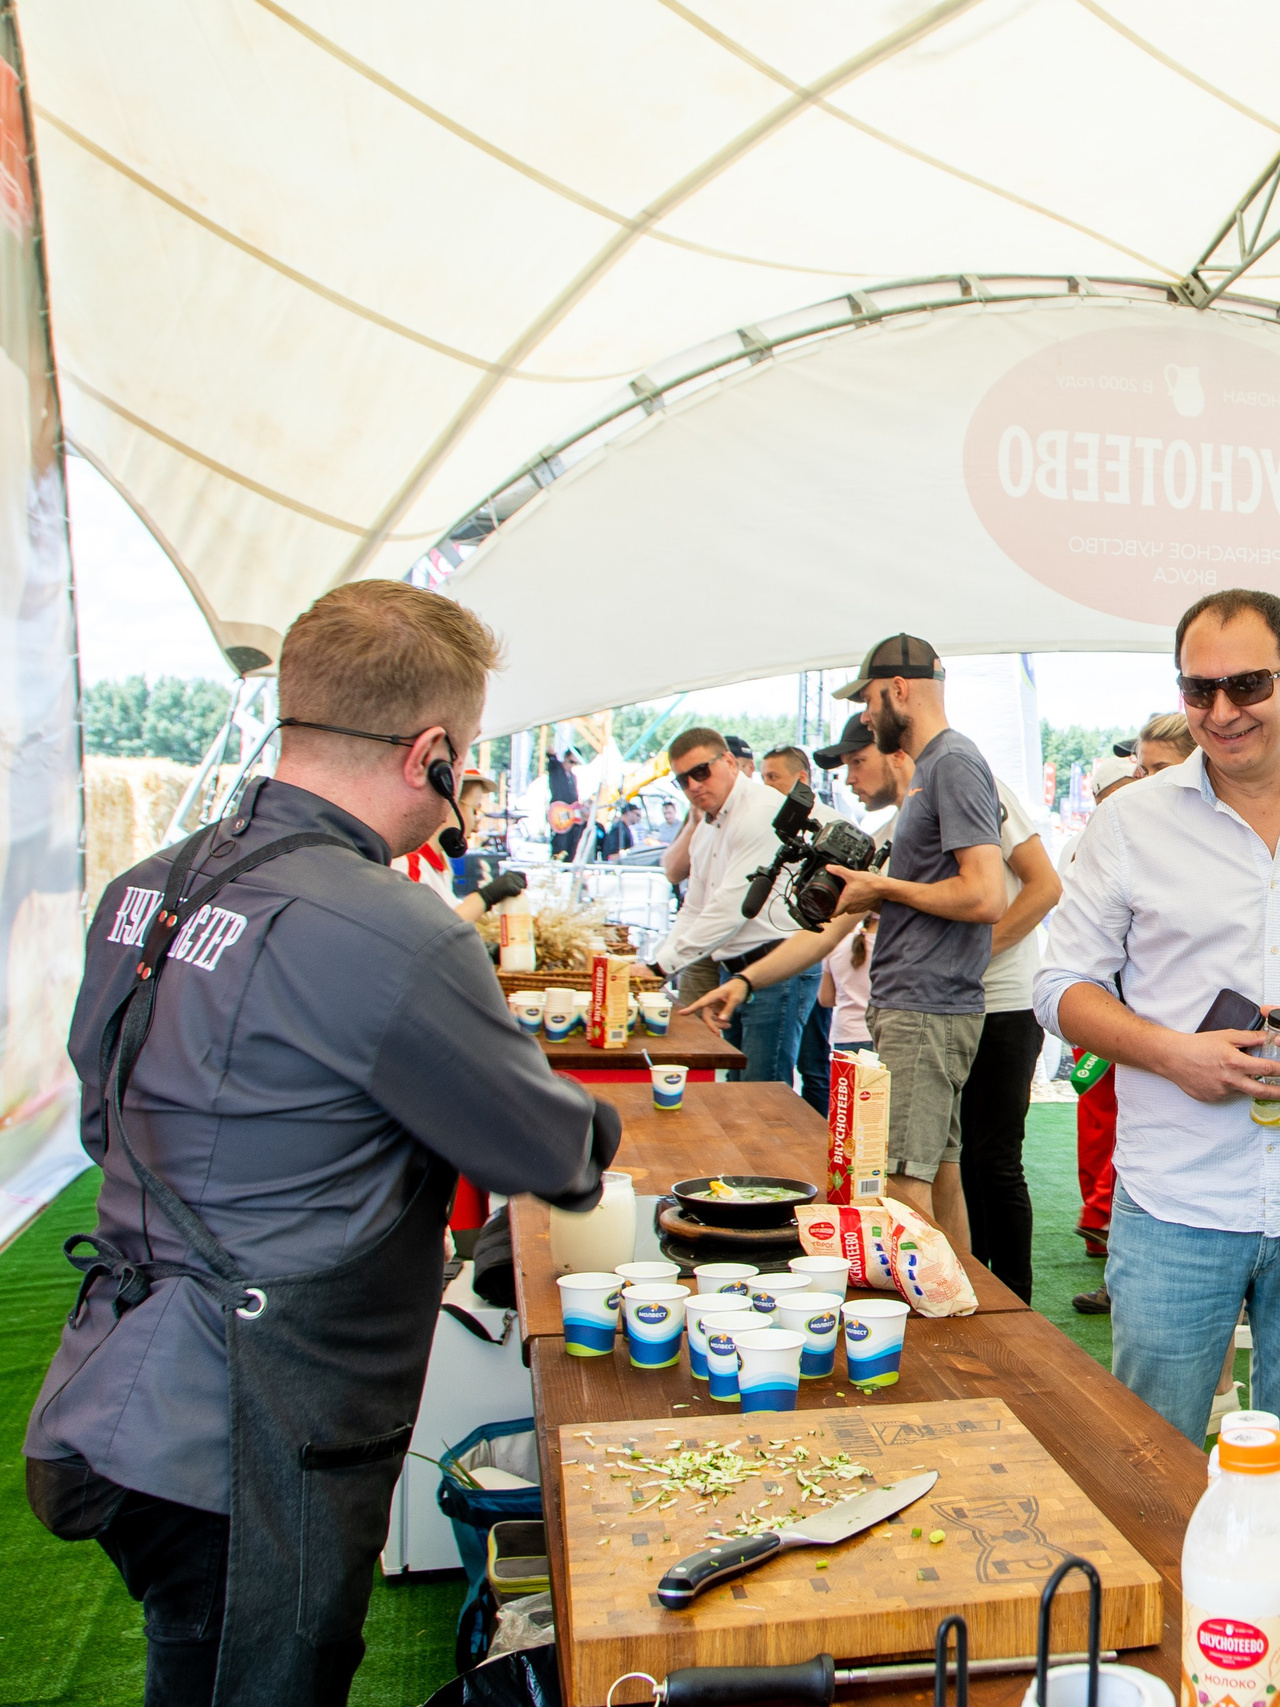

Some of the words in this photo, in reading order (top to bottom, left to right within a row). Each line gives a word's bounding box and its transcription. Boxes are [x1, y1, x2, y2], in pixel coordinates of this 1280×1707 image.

[107, 886, 248, 972] КУХАСТЕР
[833, 1076, 849, 1166] ВКУСНОТЕЕВО
[810, 1320, 835, 1329] МОЛВЕСТ
[710, 1342, 736, 1350] МОЛВЕСТ
[1200, 1630, 1265, 1654] ВКУСНОТЕЕВО
[1204, 1672, 1257, 1690] МОЛОКО
